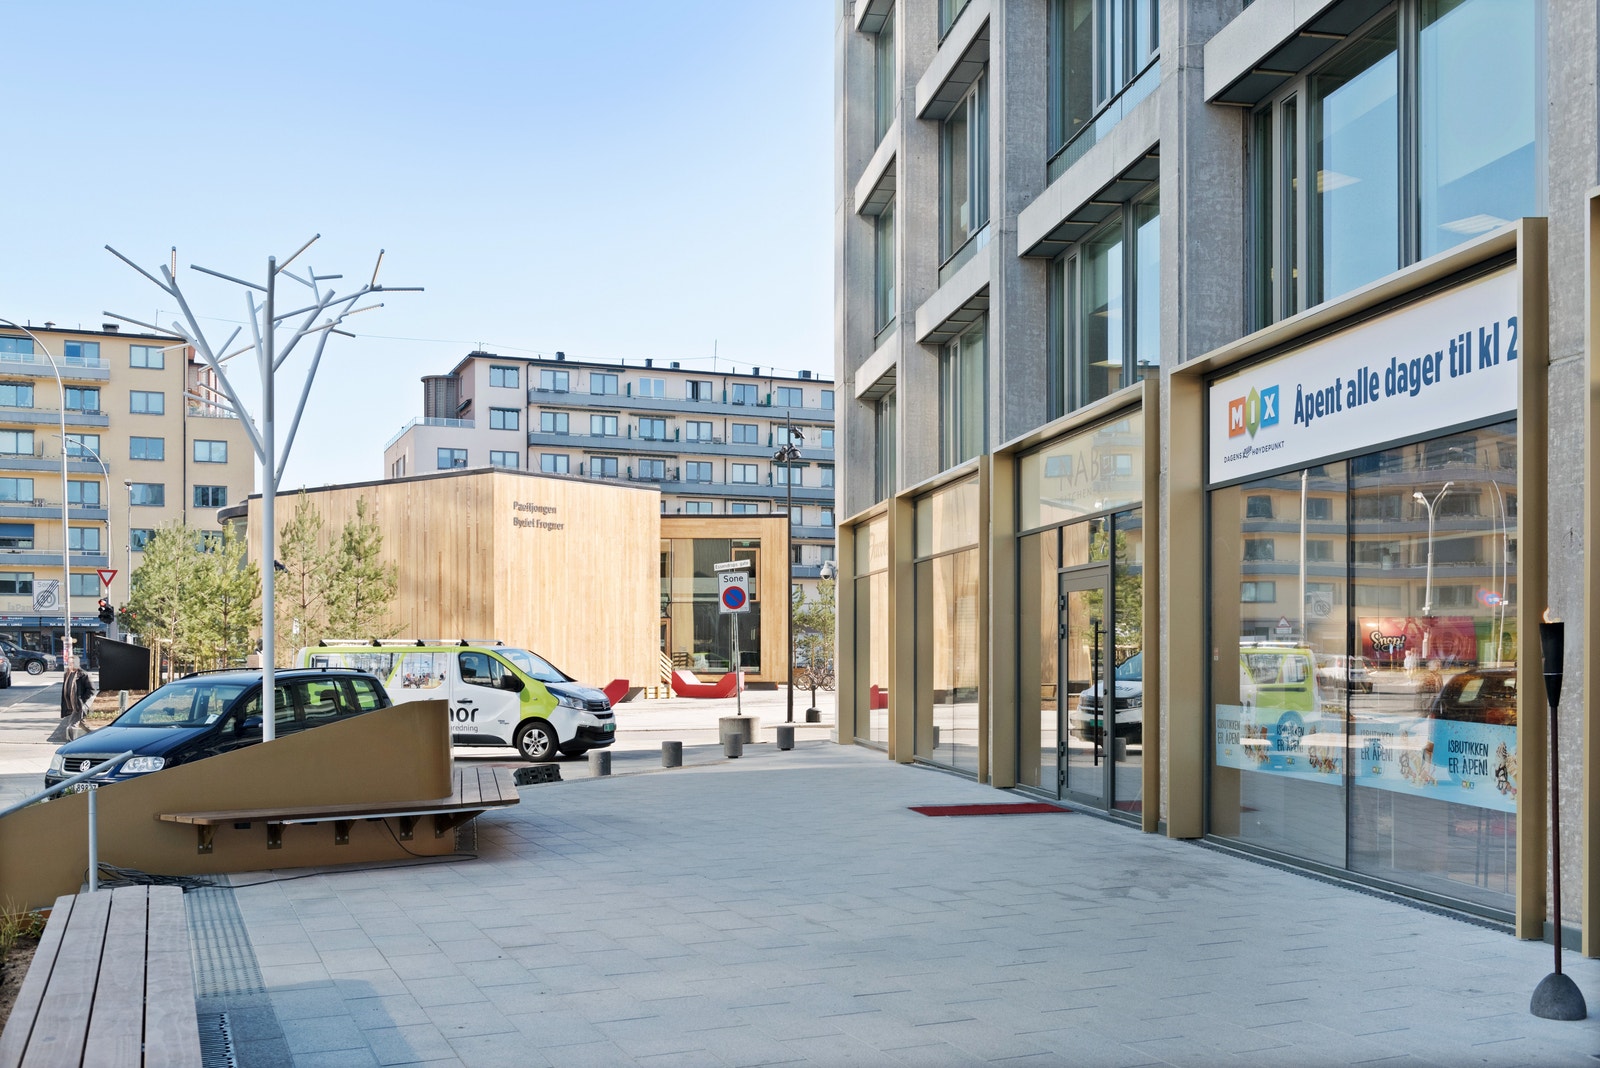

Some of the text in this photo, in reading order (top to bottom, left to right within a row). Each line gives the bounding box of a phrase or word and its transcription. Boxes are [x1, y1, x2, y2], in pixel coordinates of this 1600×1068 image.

[1294, 377, 1342, 428] Åpent
[1346, 366, 1380, 409] alle
[1385, 350, 1443, 397] dager
[1449, 331, 1472, 378] til
[1479, 321, 1500, 370] kl
[1231, 393, 1275, 430] MIX
[1224, 452, 1242, 463] DAGENS
[723, 575, 744, 583] Sone
[1448, 739, 1488, 757] ISBUTIKKEN
[1449, 755, 1488, 776] ER ÅPEN!
